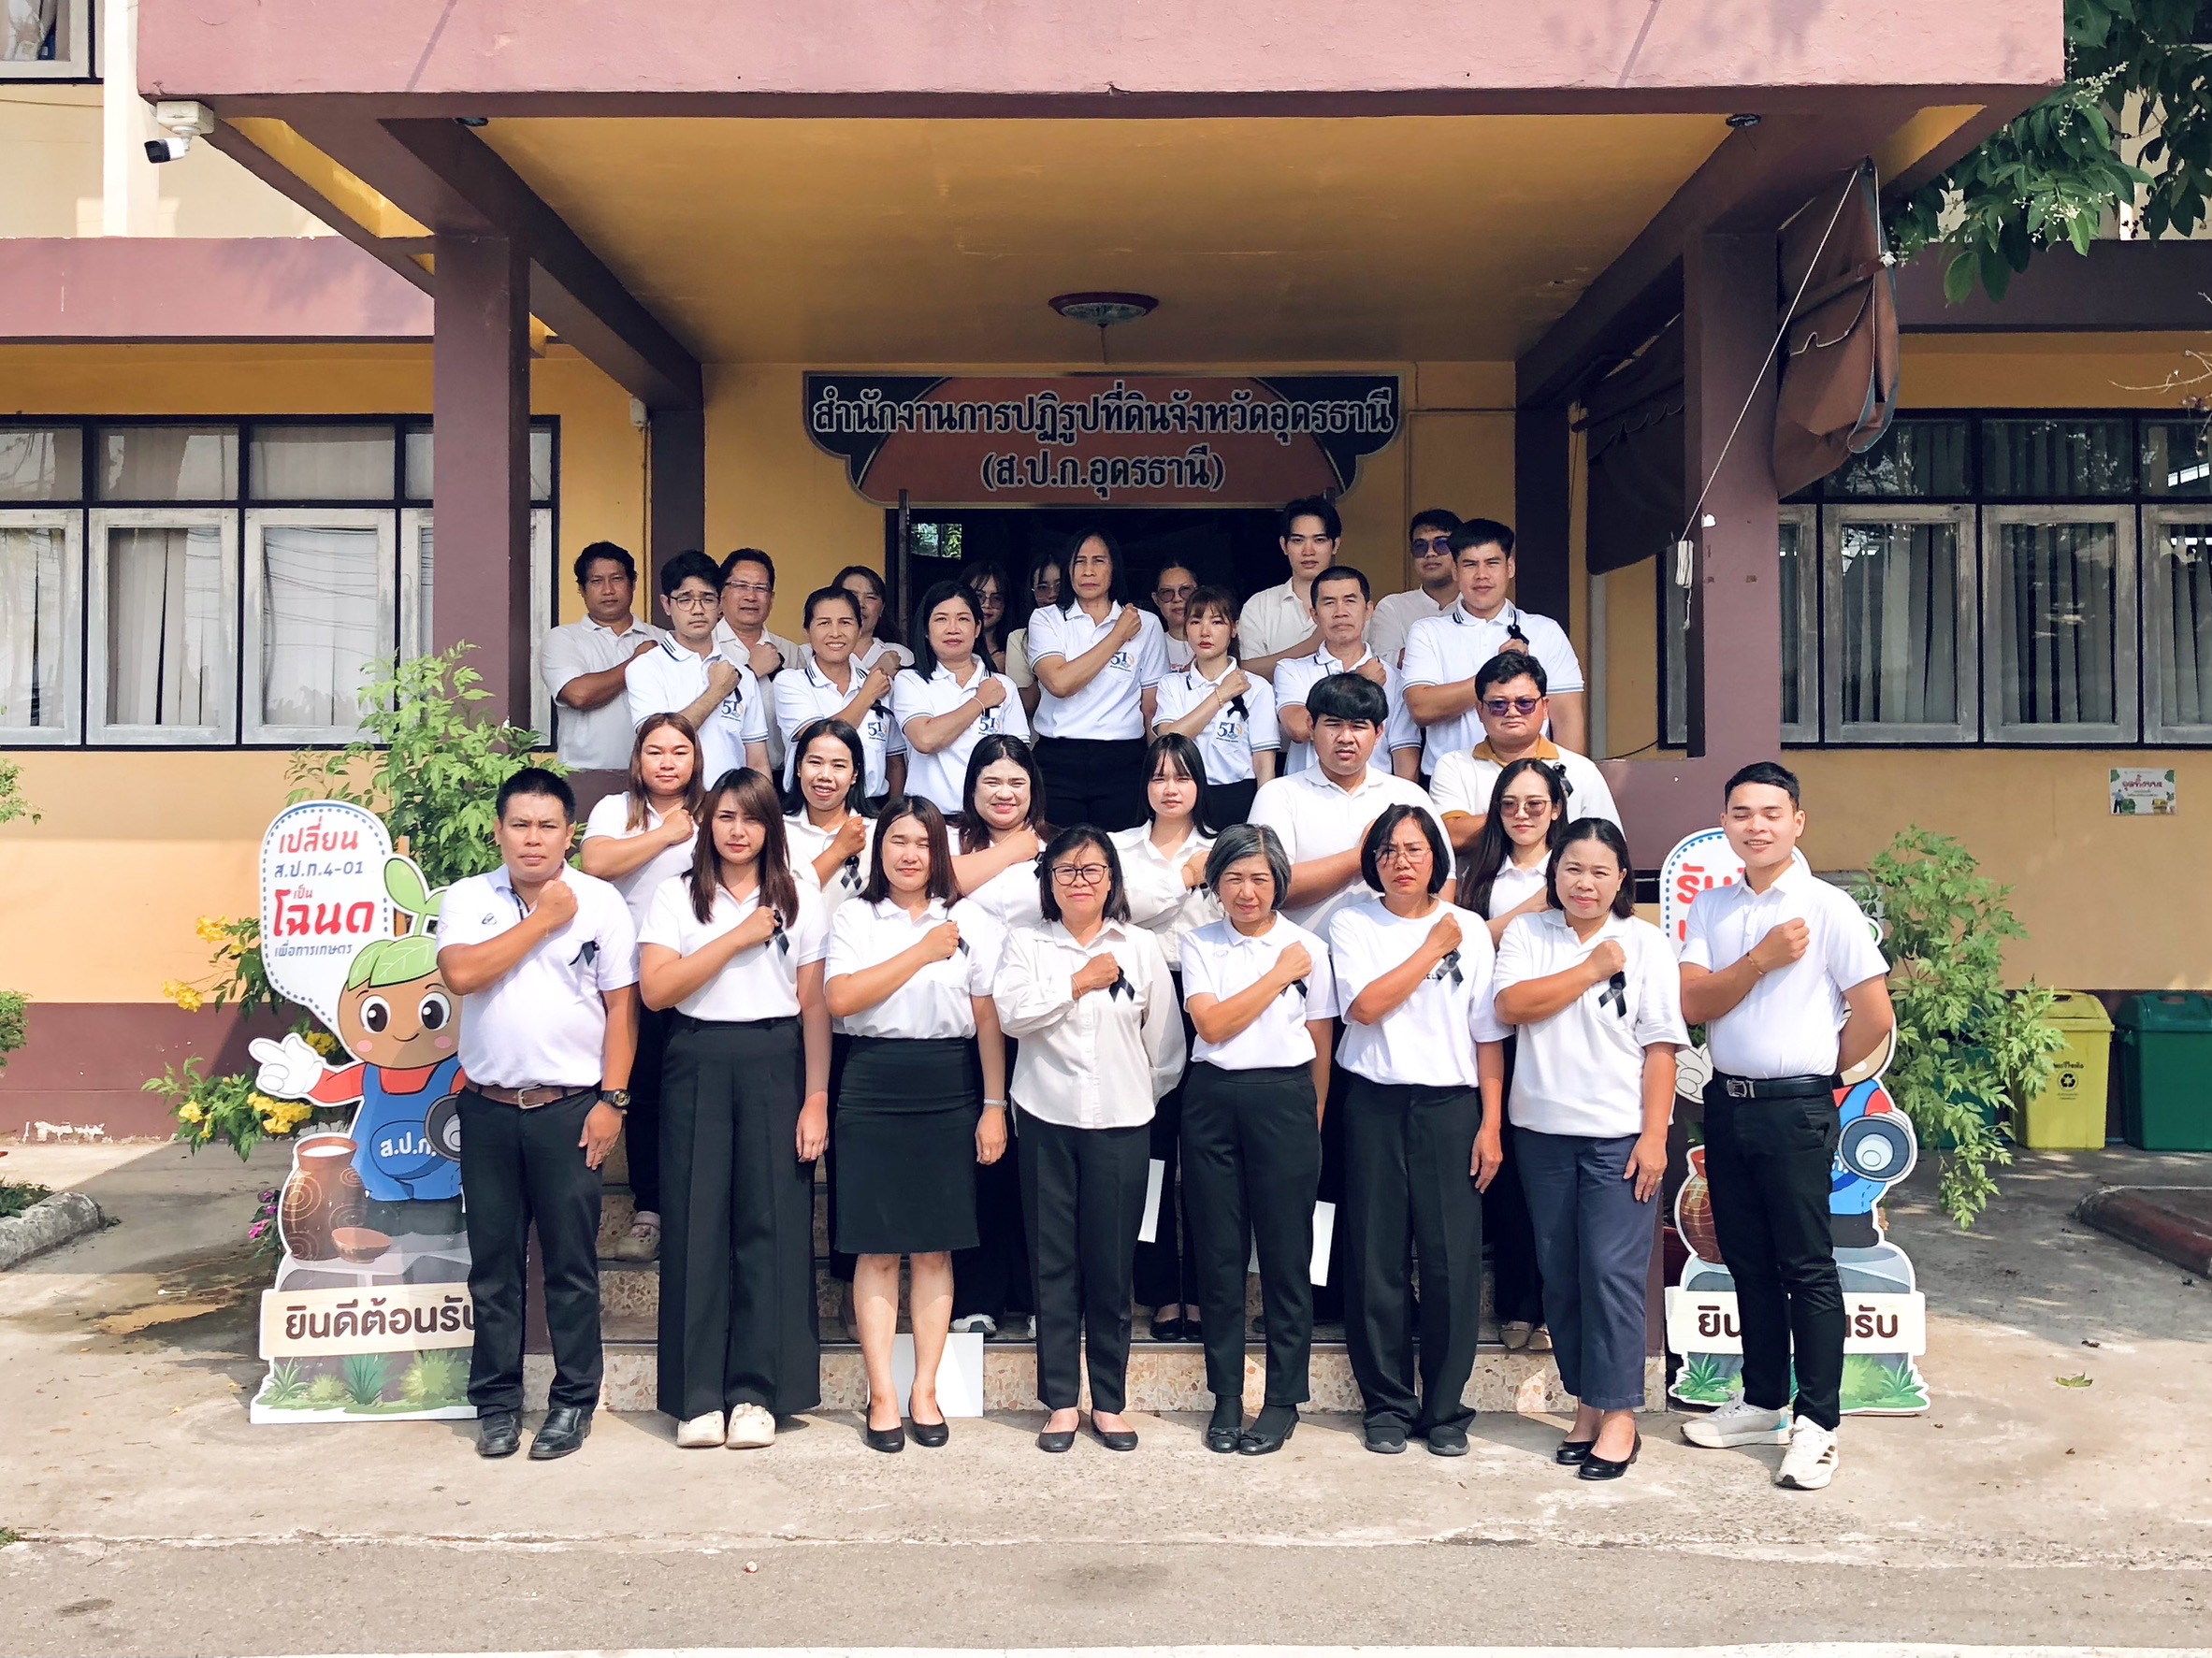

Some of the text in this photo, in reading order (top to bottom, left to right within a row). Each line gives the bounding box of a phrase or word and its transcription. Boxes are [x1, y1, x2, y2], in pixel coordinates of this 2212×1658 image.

[812, 380, 1395, 446] สำนักงานการปฏิรูปที่ดินจังหวัดอุดรธานี
[980, 442, 1226, 500] (ส.ป.ก.อุดรธานี)
[721, 699, 737, 714] 51
[868, 722, 882, 736] 51
[978, 716, 995, 731] 51
[1217, 722, 1235, 737] 51
[279, 815, 358, 854] เปลี่ยน
[274, 860, 363, 878] ส.ป.ก.4-01
[293, 884, 313, 900] เป็น
[273, 888, 375, 936] โฉนด
[274, 940, 353, 957] เพื่อการเกษตร
